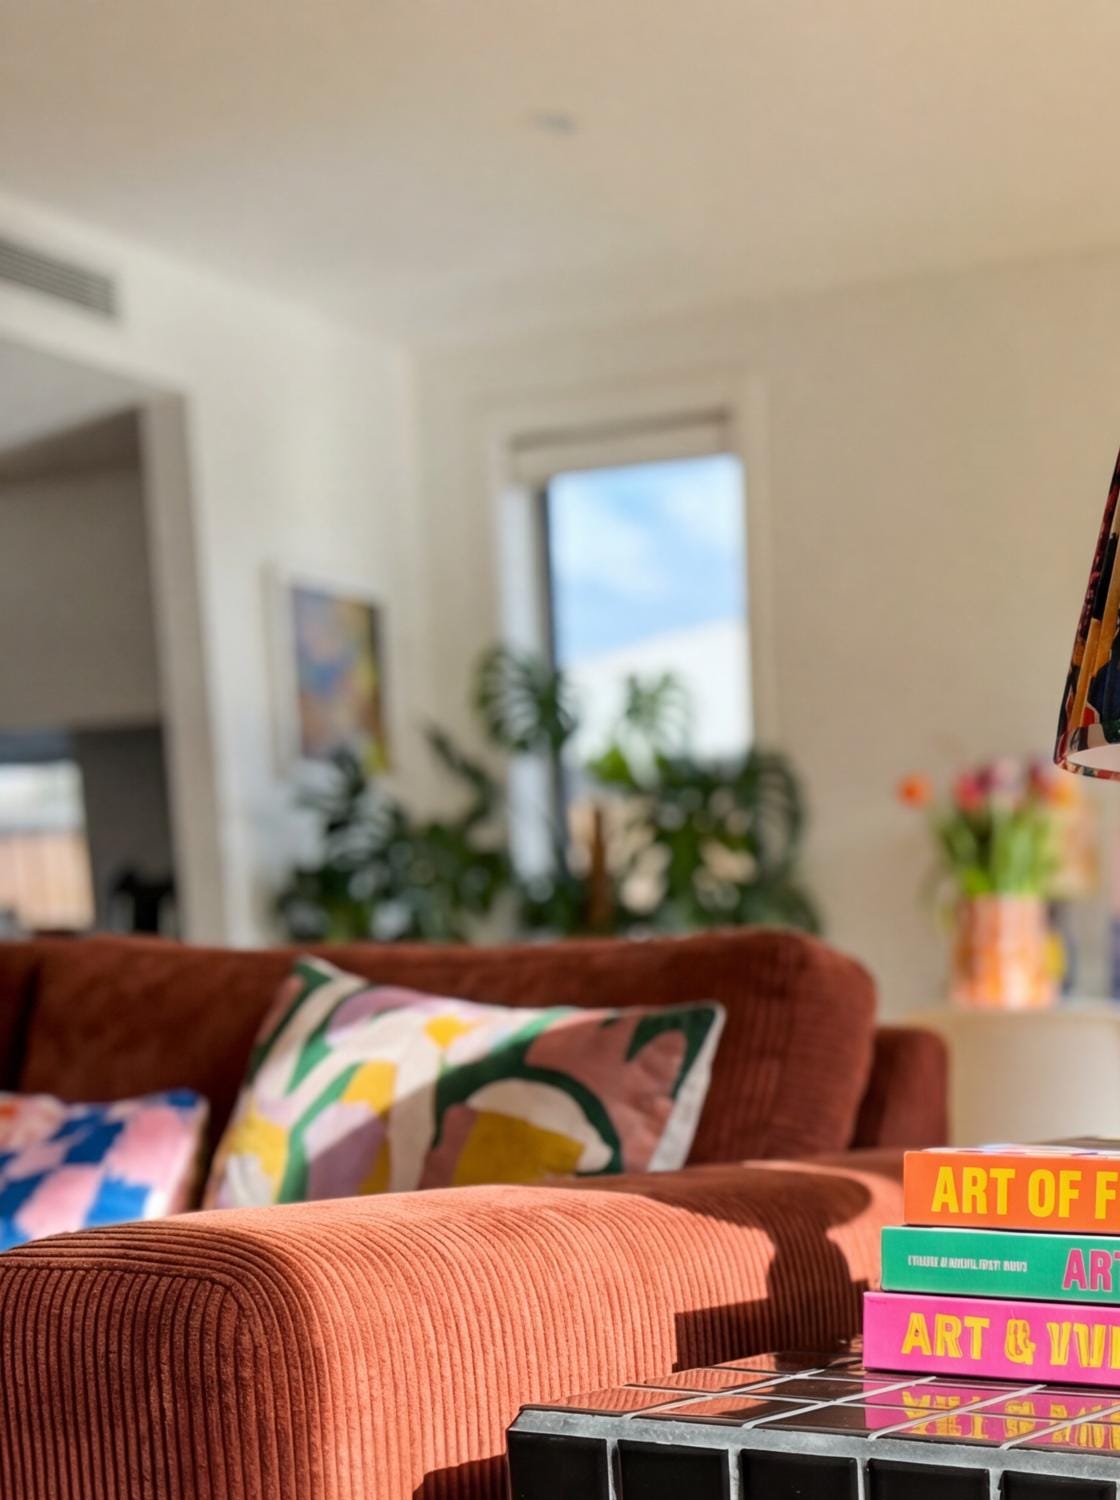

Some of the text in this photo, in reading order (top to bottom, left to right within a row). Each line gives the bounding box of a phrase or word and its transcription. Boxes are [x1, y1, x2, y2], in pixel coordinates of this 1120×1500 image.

[931, 1166, 1016, 1214] ART
[1028, 1169, 1083, 1219] OF
[900, 1312, 991, 1361] ART
